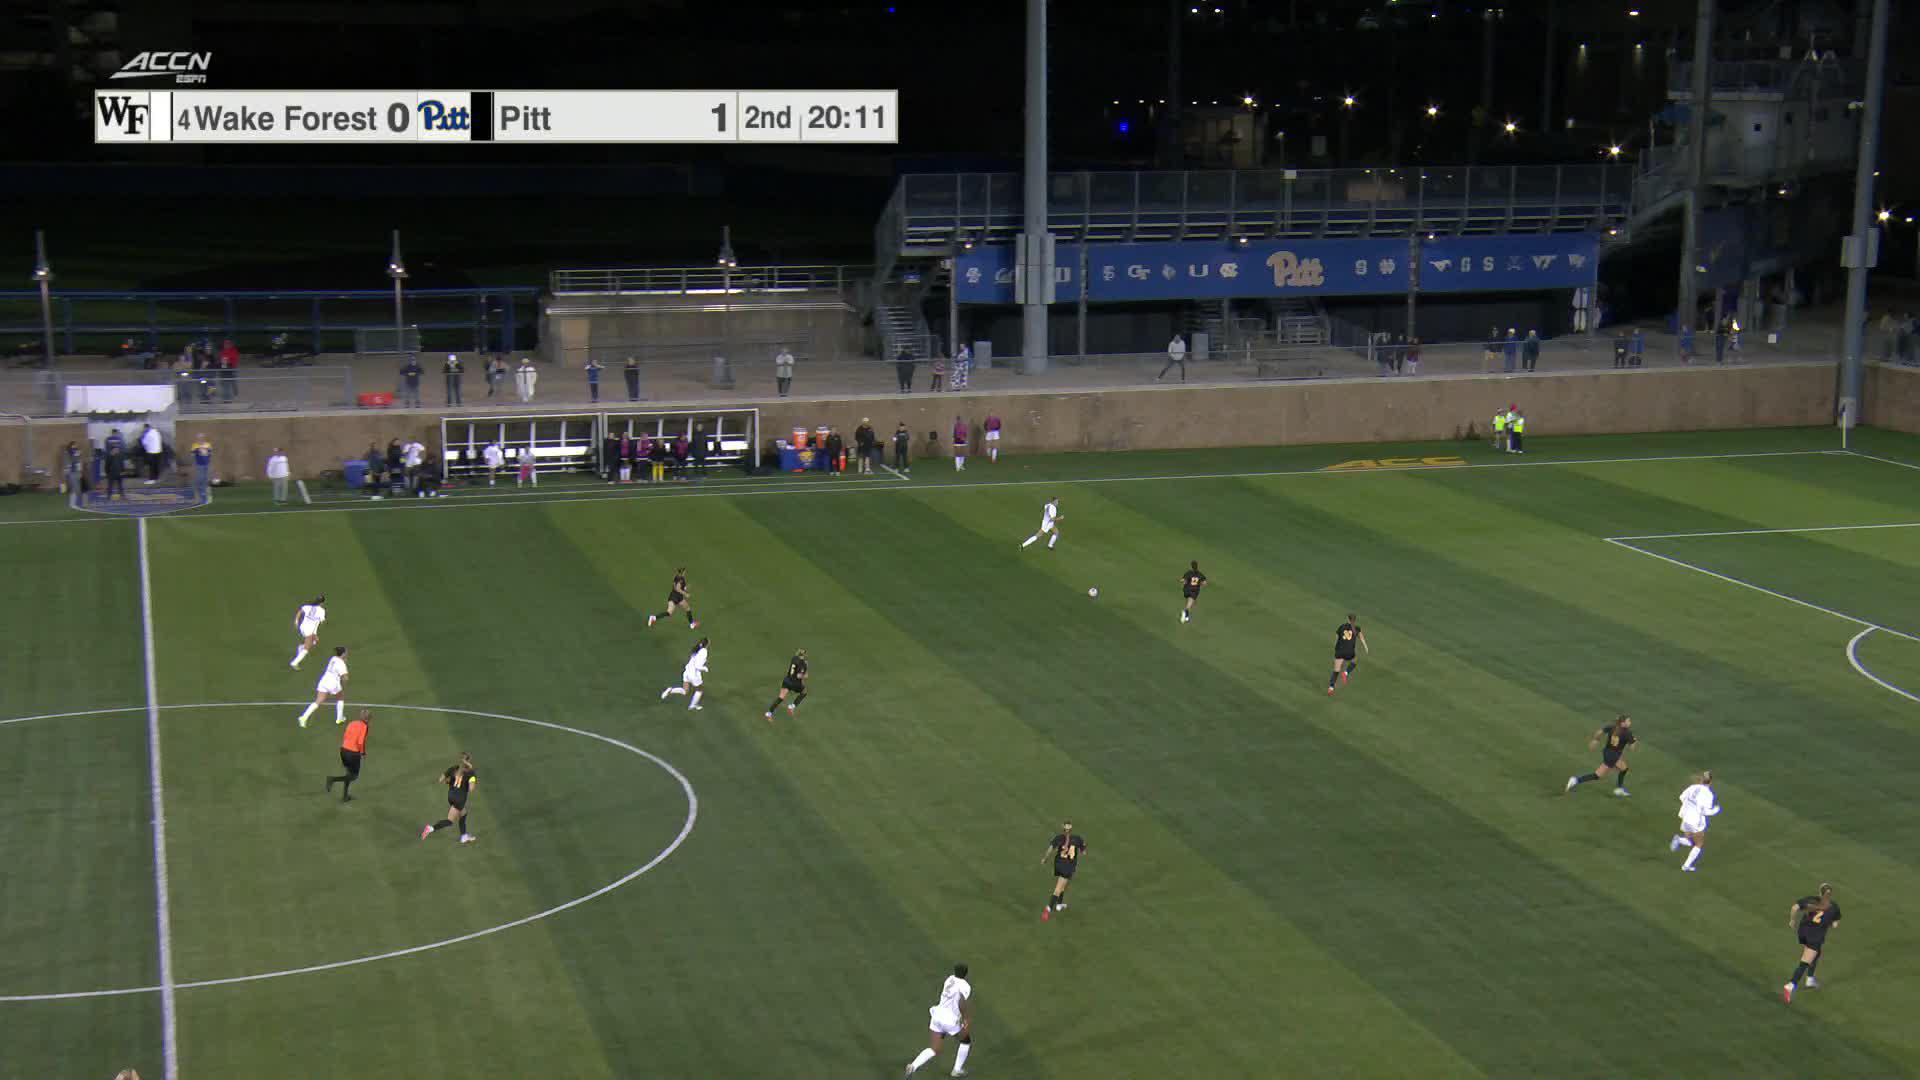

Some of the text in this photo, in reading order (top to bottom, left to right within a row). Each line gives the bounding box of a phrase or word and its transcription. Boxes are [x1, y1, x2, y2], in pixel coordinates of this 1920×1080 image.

[1266, 250, 1325, 287] Pitt
[1325, 456, 1467, 470] ACC
[1060, 844, 1076, 860] 24
[1812, 910, 1824, 924] 2
